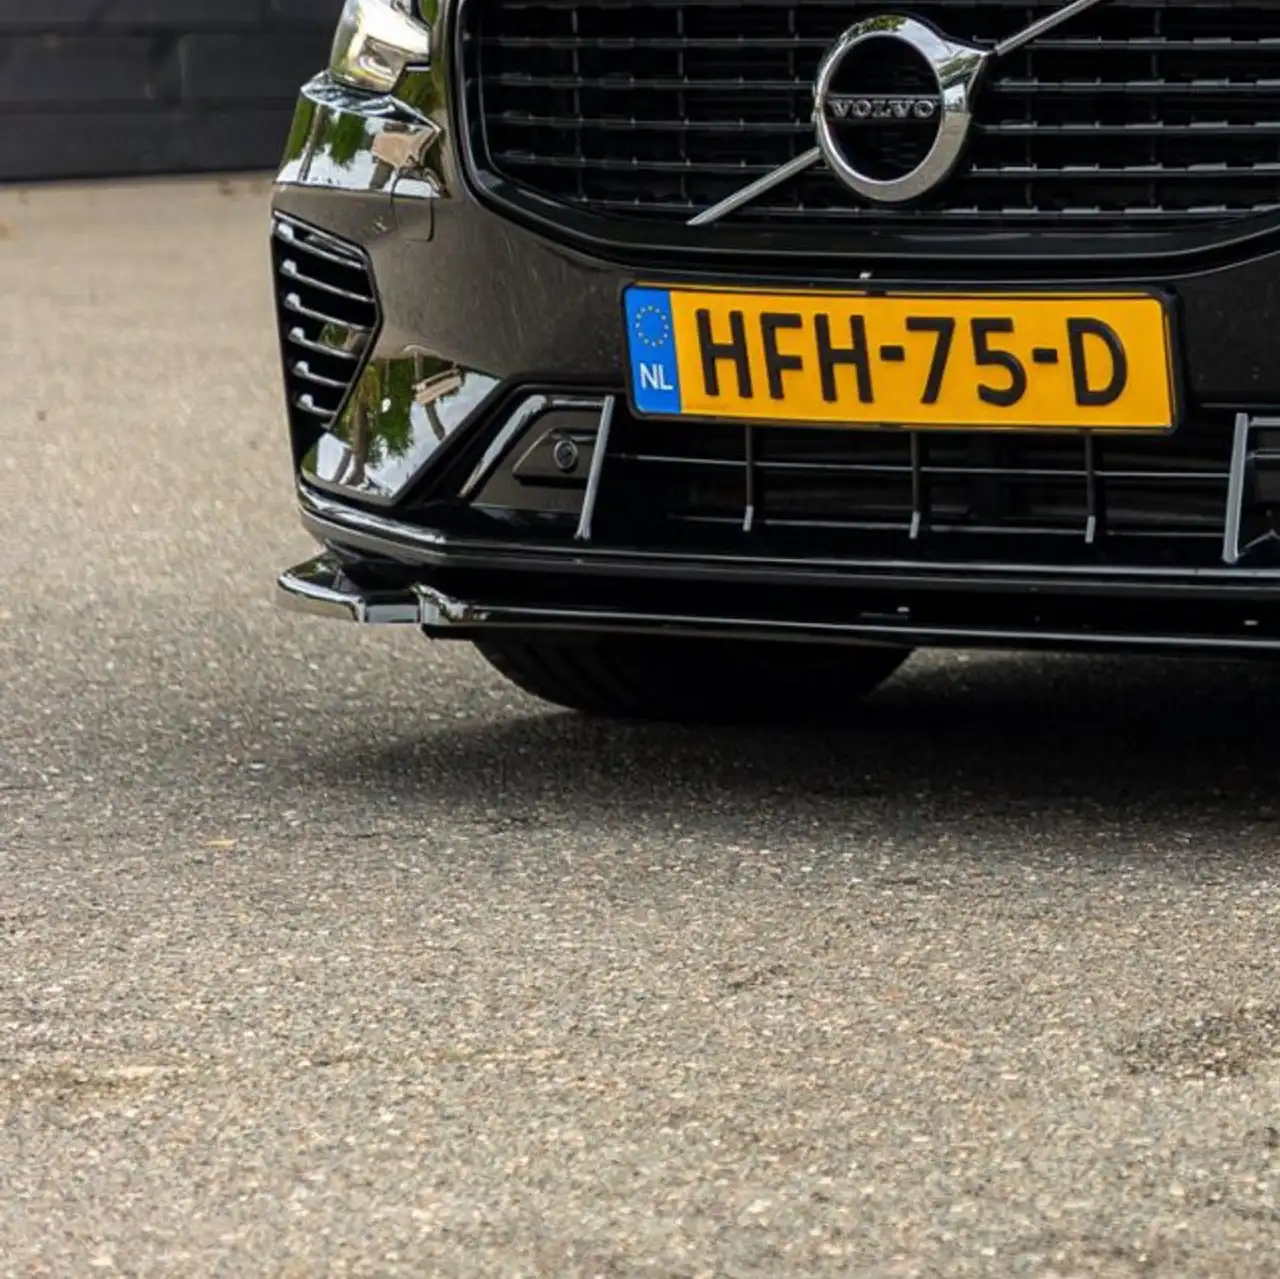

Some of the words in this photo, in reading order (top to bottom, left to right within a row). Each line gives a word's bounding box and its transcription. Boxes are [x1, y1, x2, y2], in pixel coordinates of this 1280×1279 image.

[828, 99, 936, 118] VOLVO
[695, 309, 1128, 407] HFH-75-D
[639, 363, 673, 390] NL
